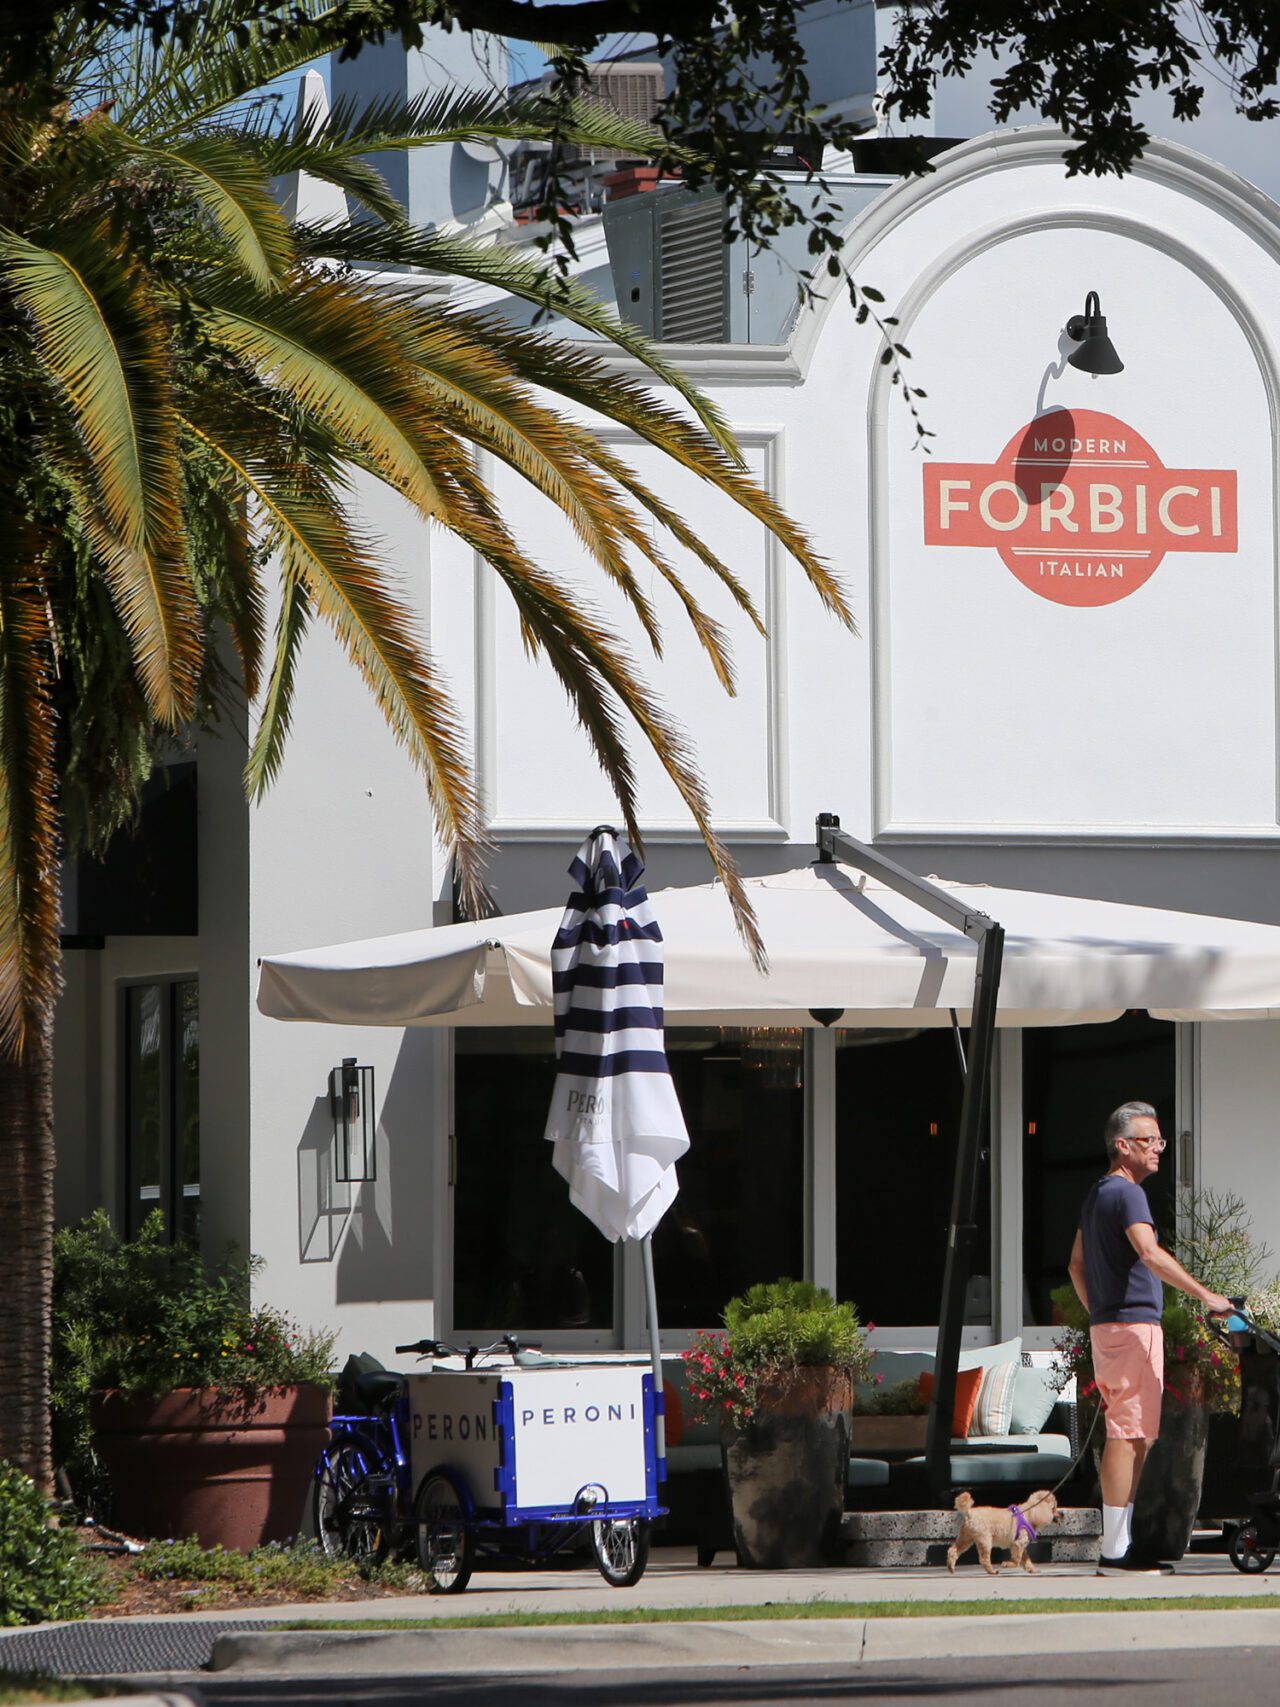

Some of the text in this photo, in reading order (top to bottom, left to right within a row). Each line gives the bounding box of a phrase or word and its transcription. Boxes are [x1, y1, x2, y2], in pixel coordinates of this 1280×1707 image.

[1034, 437, 1128, 454] MODERN
[939, 479, 1223, 537] FORBICI
[1040, 561, 1124, 578] ITALIAN
[522, 1404, 636, 1427] PERONI
